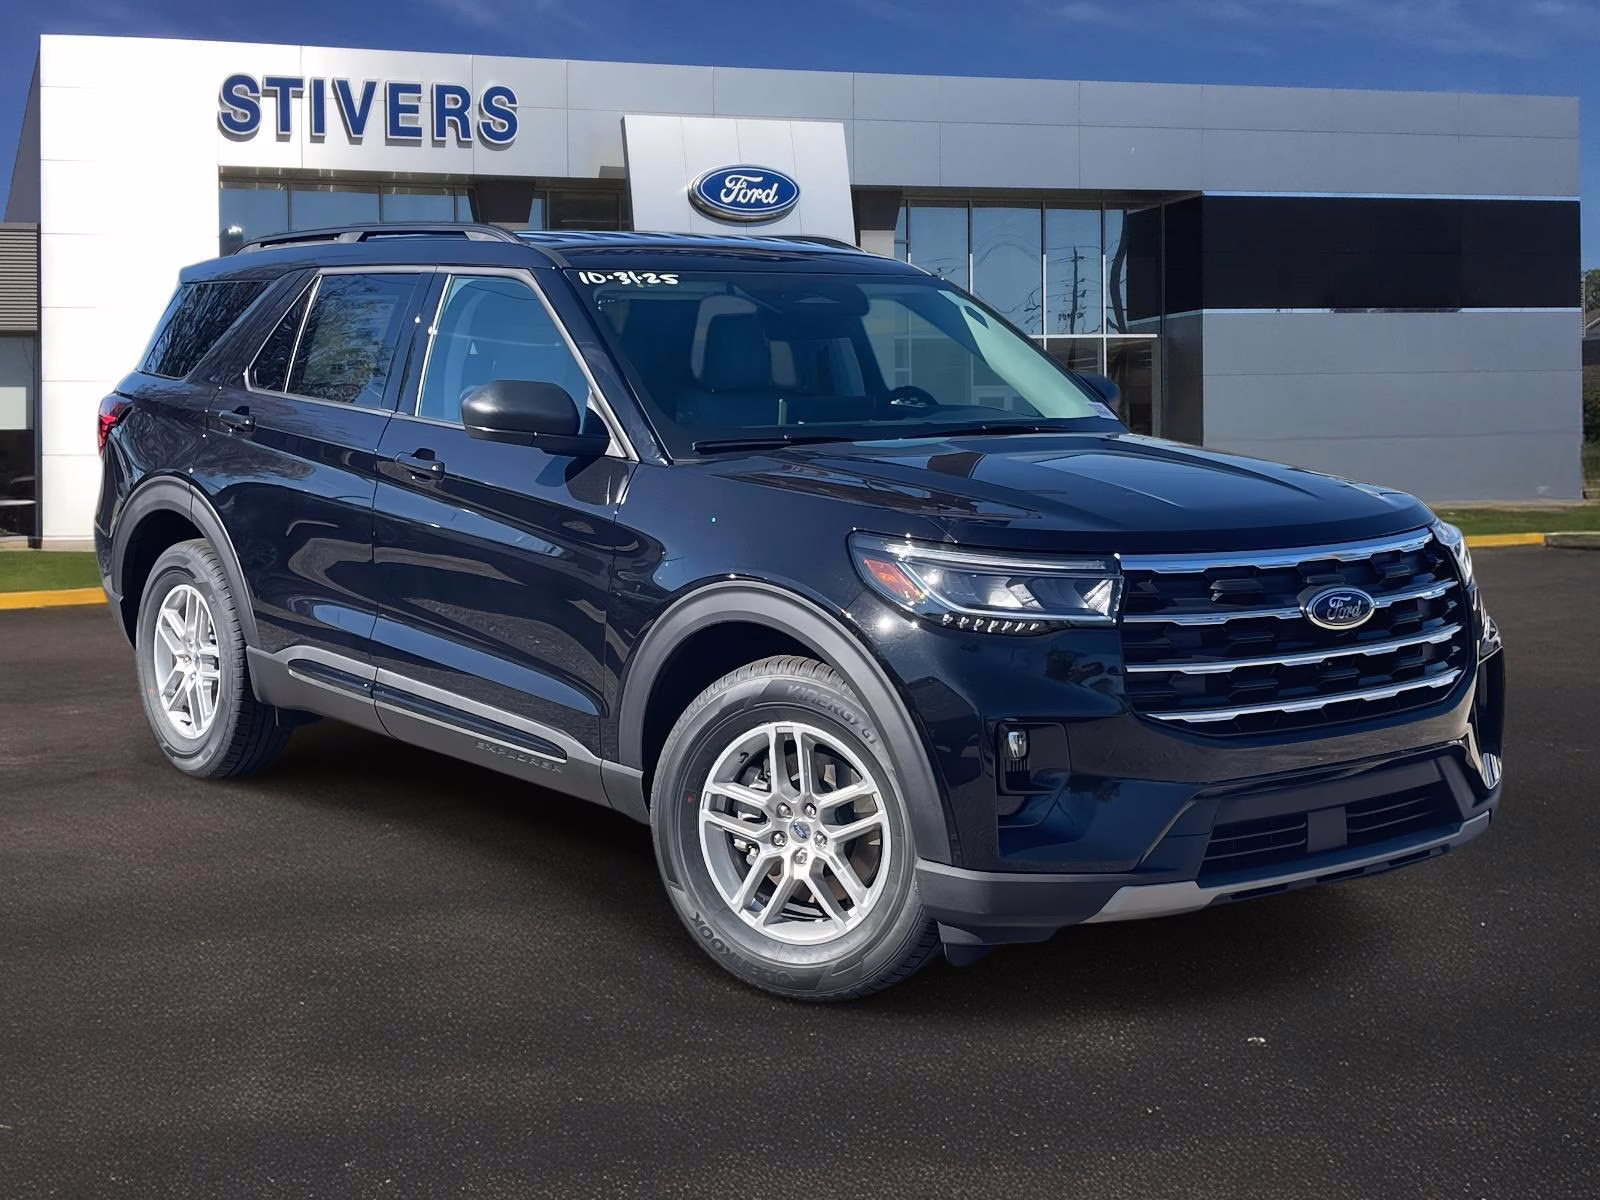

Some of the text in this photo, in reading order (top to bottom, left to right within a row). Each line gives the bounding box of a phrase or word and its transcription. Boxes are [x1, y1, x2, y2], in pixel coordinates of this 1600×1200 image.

[217, 73, 520, 147] STIVERS
[720, 174, 779, 204] Ford
[1326, 596, 1362, 621] Ford
[475, 740, 563, 774] EXPLORER
